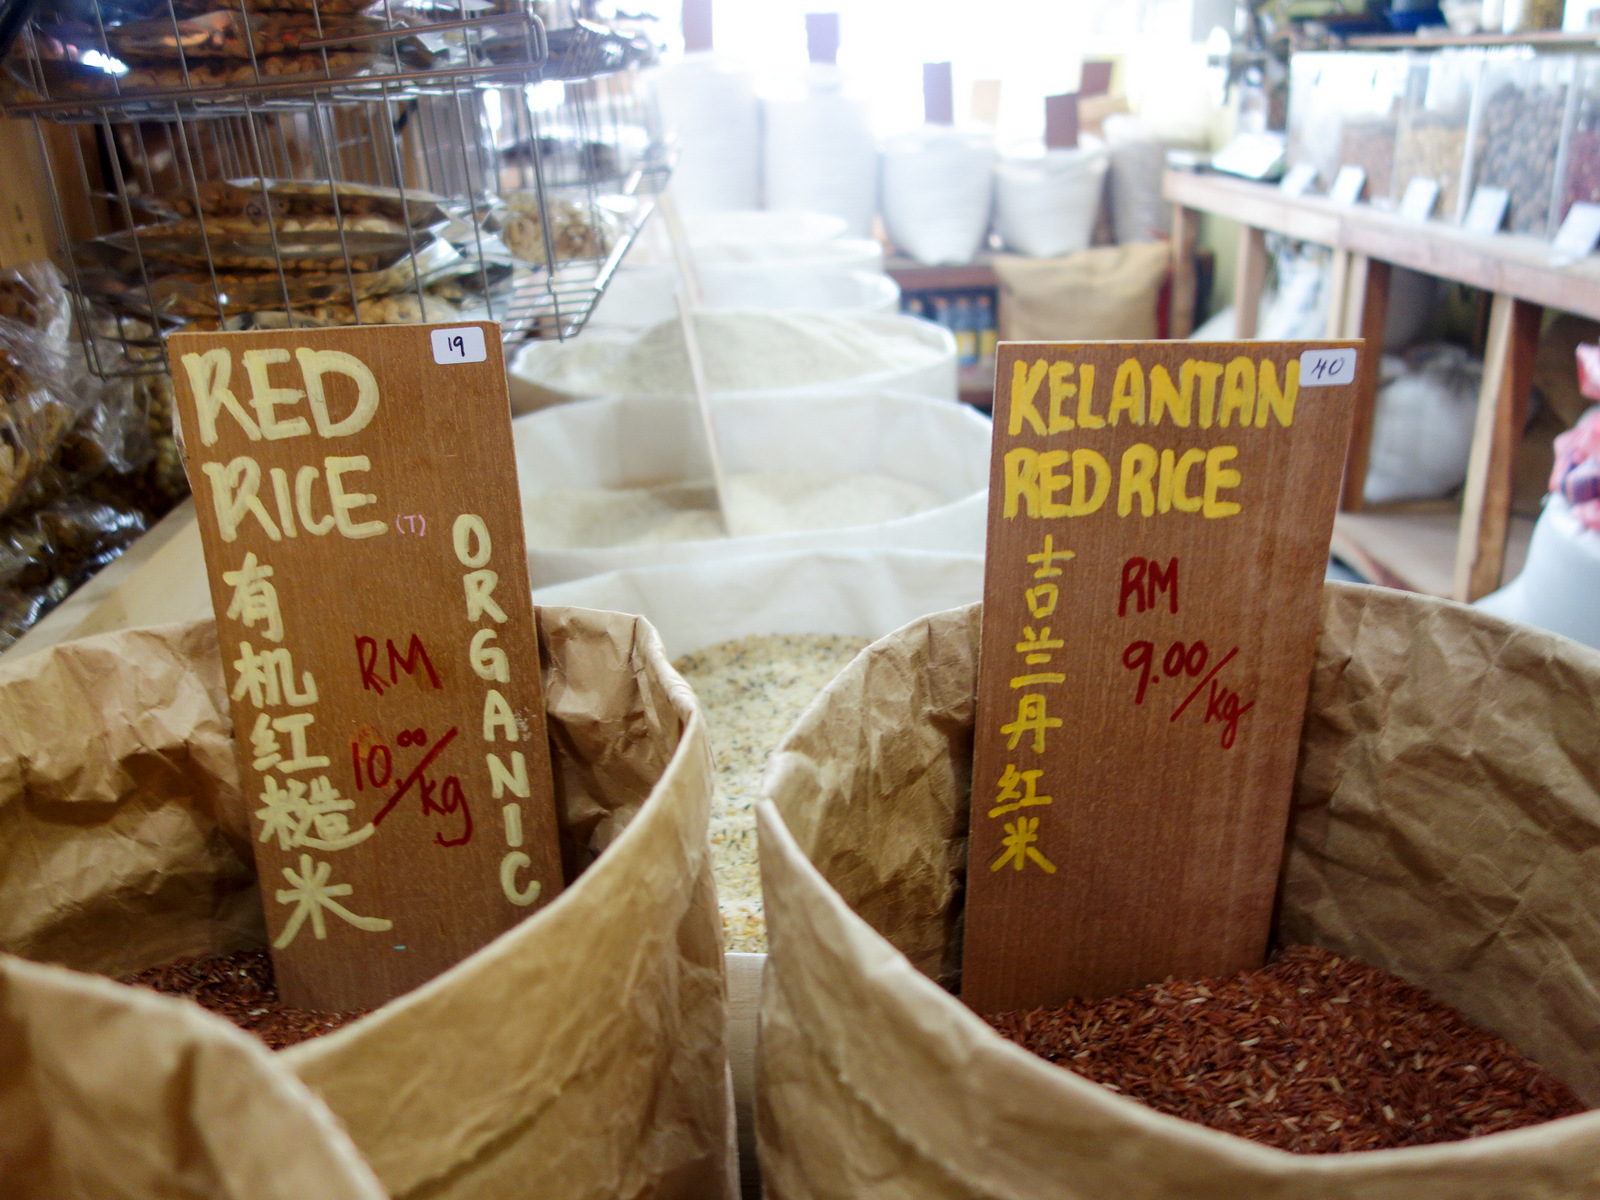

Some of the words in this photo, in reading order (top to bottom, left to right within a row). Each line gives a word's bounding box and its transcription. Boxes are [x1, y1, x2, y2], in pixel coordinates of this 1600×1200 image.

[447, 336, 466, 357] 19
[1311, 356, 1345, 379] 40
[181, 347, 380, 447] RED
[1008, 356, 1301, 436] KELANTAN
[201, 455, 389, 543] RICE
[395, 514, 426, 537] (T)
[1003, 447, 1112, 521] RED
[1117, 443, 1242, 520] RICE
[1117, 556, 1179, 618] RM
[354, 633, 444, 696] RM
[988, 534, 1077, 875] 吉兰丹红米
[451, 513, 542, 907] ORGANIC
[222, 551, 394, 951] 有机红糙米
